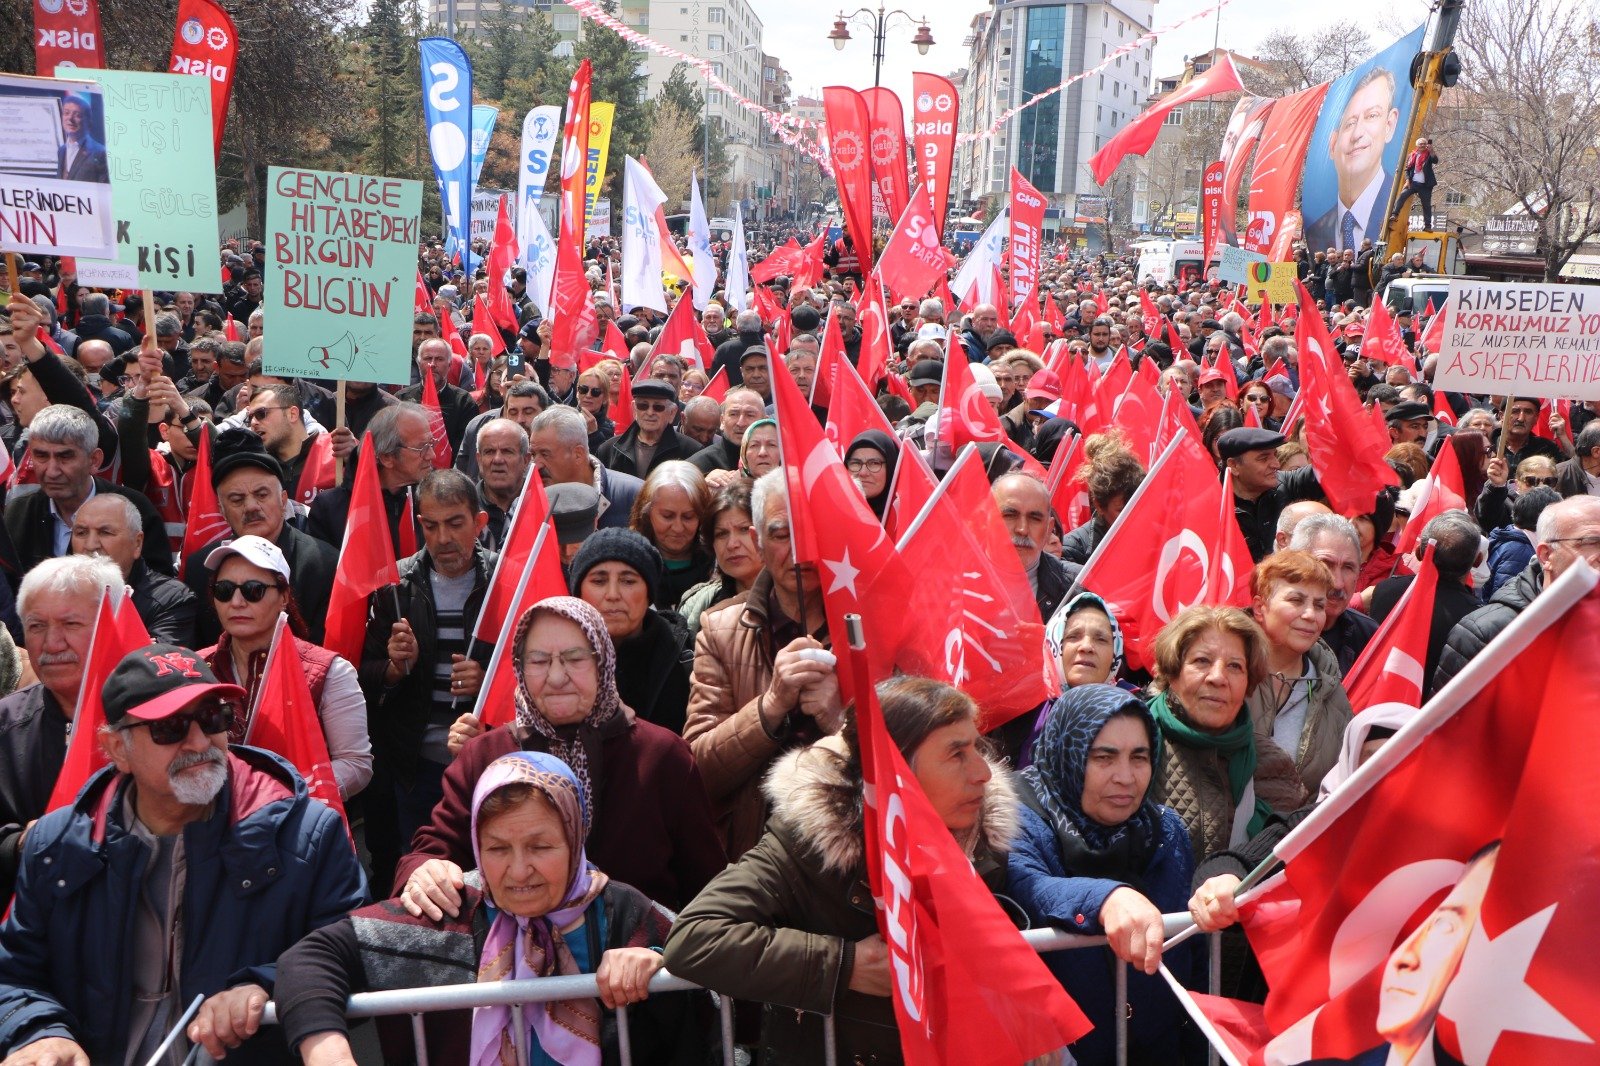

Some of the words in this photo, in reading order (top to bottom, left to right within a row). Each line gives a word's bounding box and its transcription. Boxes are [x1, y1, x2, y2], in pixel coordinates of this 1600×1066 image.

[140, 187, 212, 219] GÜLE
[276, 171, 402, 208] GENÇLİĞE
[1016, 192, 1041, 208] CHP
[1205, 186, 1223, 195] DİSK
[291, 201, 418, 245] HİTABE'DEKİ
[1210, 198, 1219, 247] GENEL
[138, 243, 195, 279] KİŞİ
[275, 232, 374, 269] BİRGÜN
[909, 241, 945, 271] PARTİ
[1458, 287, 1585, 313] KİMSEDEN
[1455, 312, 1572, 334] KORKUMUZ
[1578, 314, 1600, 335] YO
[1451, 333, 1475, 348] BİZ
[1481, 335, 1548, 349] MUSTAFA
